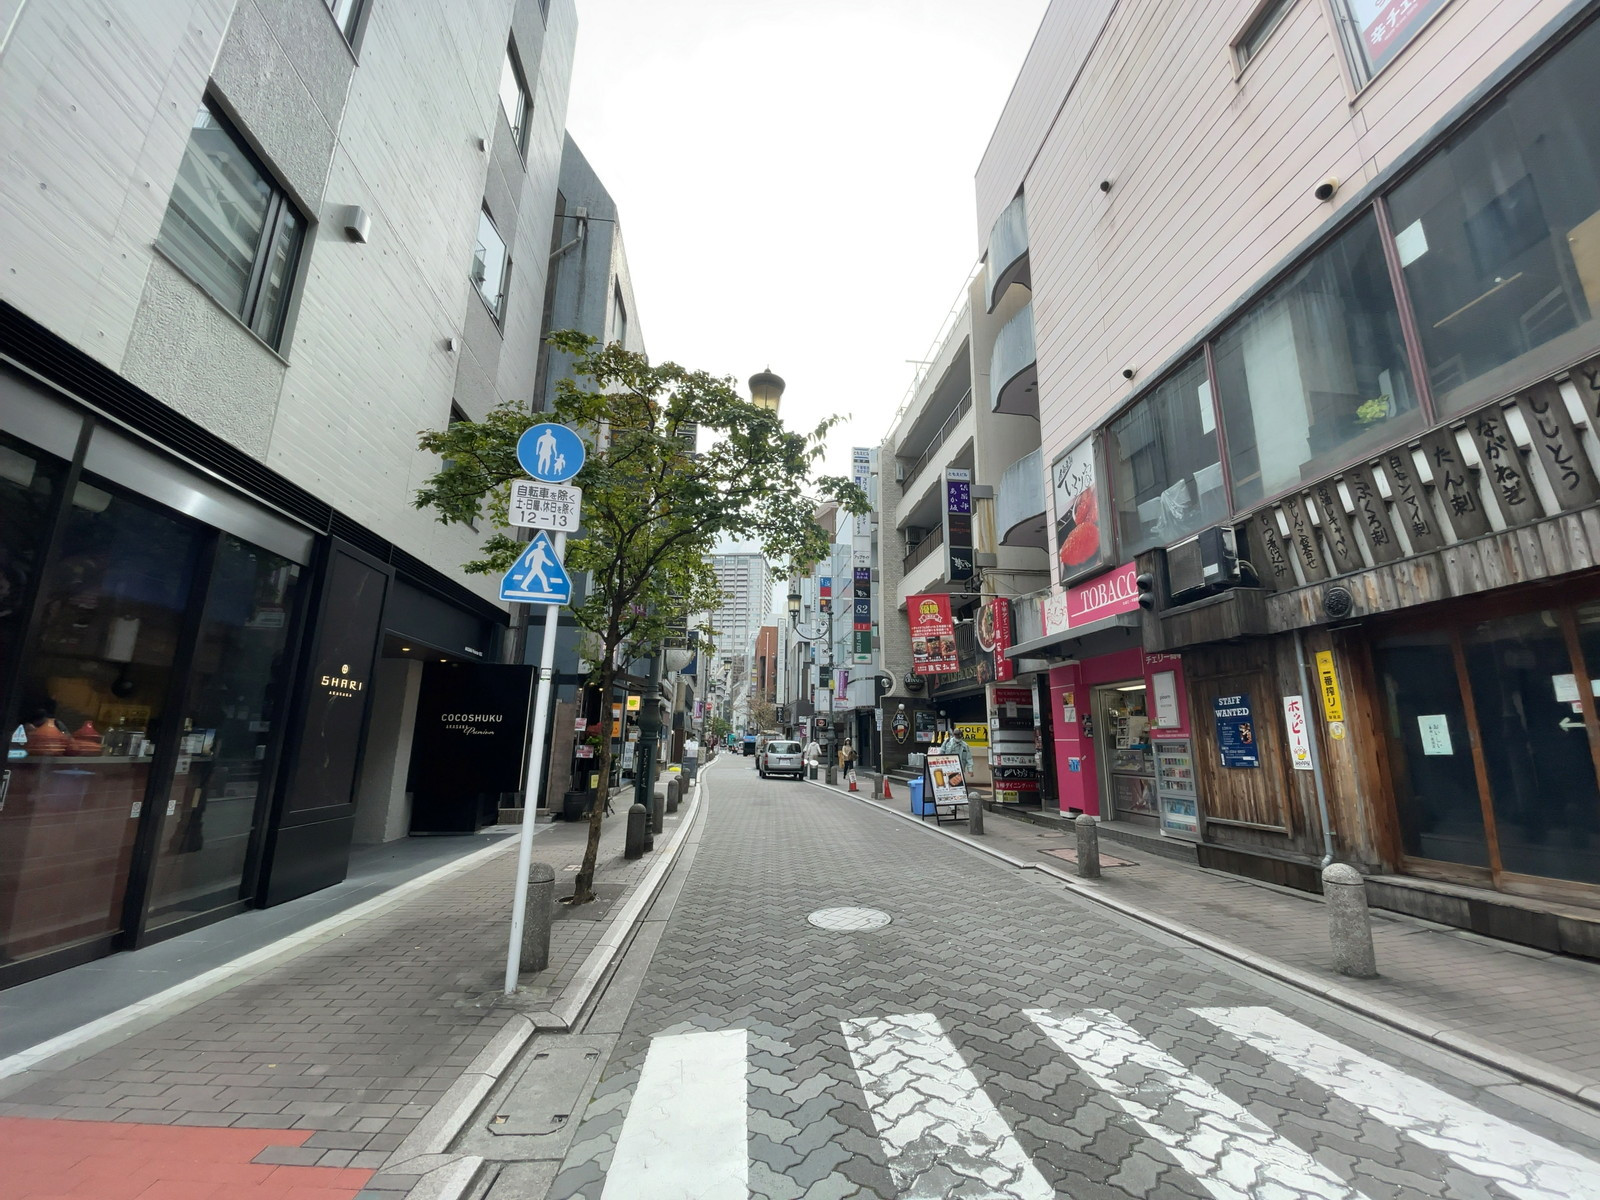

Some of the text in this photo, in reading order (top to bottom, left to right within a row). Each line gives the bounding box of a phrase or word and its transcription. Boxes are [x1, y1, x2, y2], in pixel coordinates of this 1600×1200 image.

[1528, 396, 1580, 490] ししとう
[1475, 418, 1526, 506] ながねぎ
[516, 485, 575, 503] 自転車を除く
[1434, 446, 1476, 517] たん刺
[1260, 514, 1288, 577] もつ煮込み
[856, 604, 868, 614] 82
[321, 676, 363, 691] SHARI
[1323, 671, 1336, 707] 一番搾り
[1215, 707, 1250, 718] WANTED
[1218, 696, 1242, 706] STAFF
[441, 713, 503, 723] COCOSHUKU
[1288, 701, 1304, 746] ホッピー
